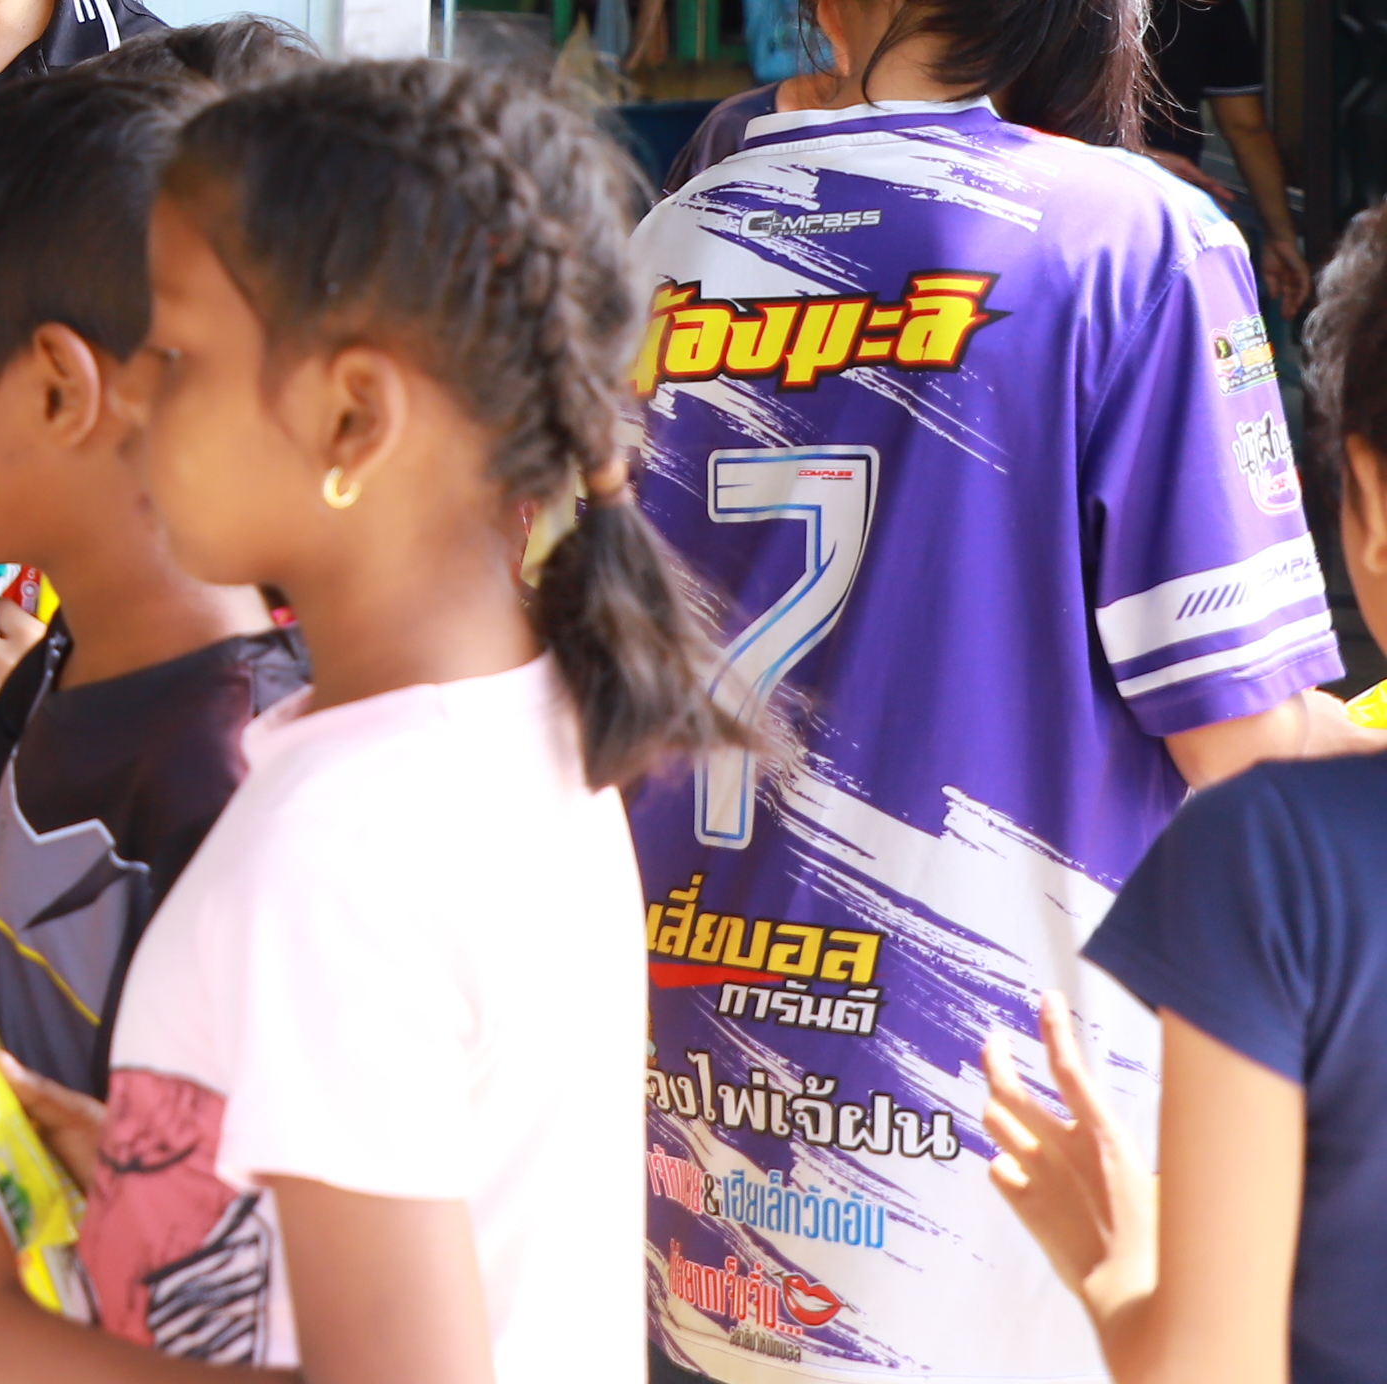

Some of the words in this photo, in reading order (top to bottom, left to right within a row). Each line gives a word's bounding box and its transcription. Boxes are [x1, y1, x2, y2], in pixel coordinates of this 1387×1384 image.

[694, 444, 880, 850] 7
[719, 982, 879, 1036] การันตี
